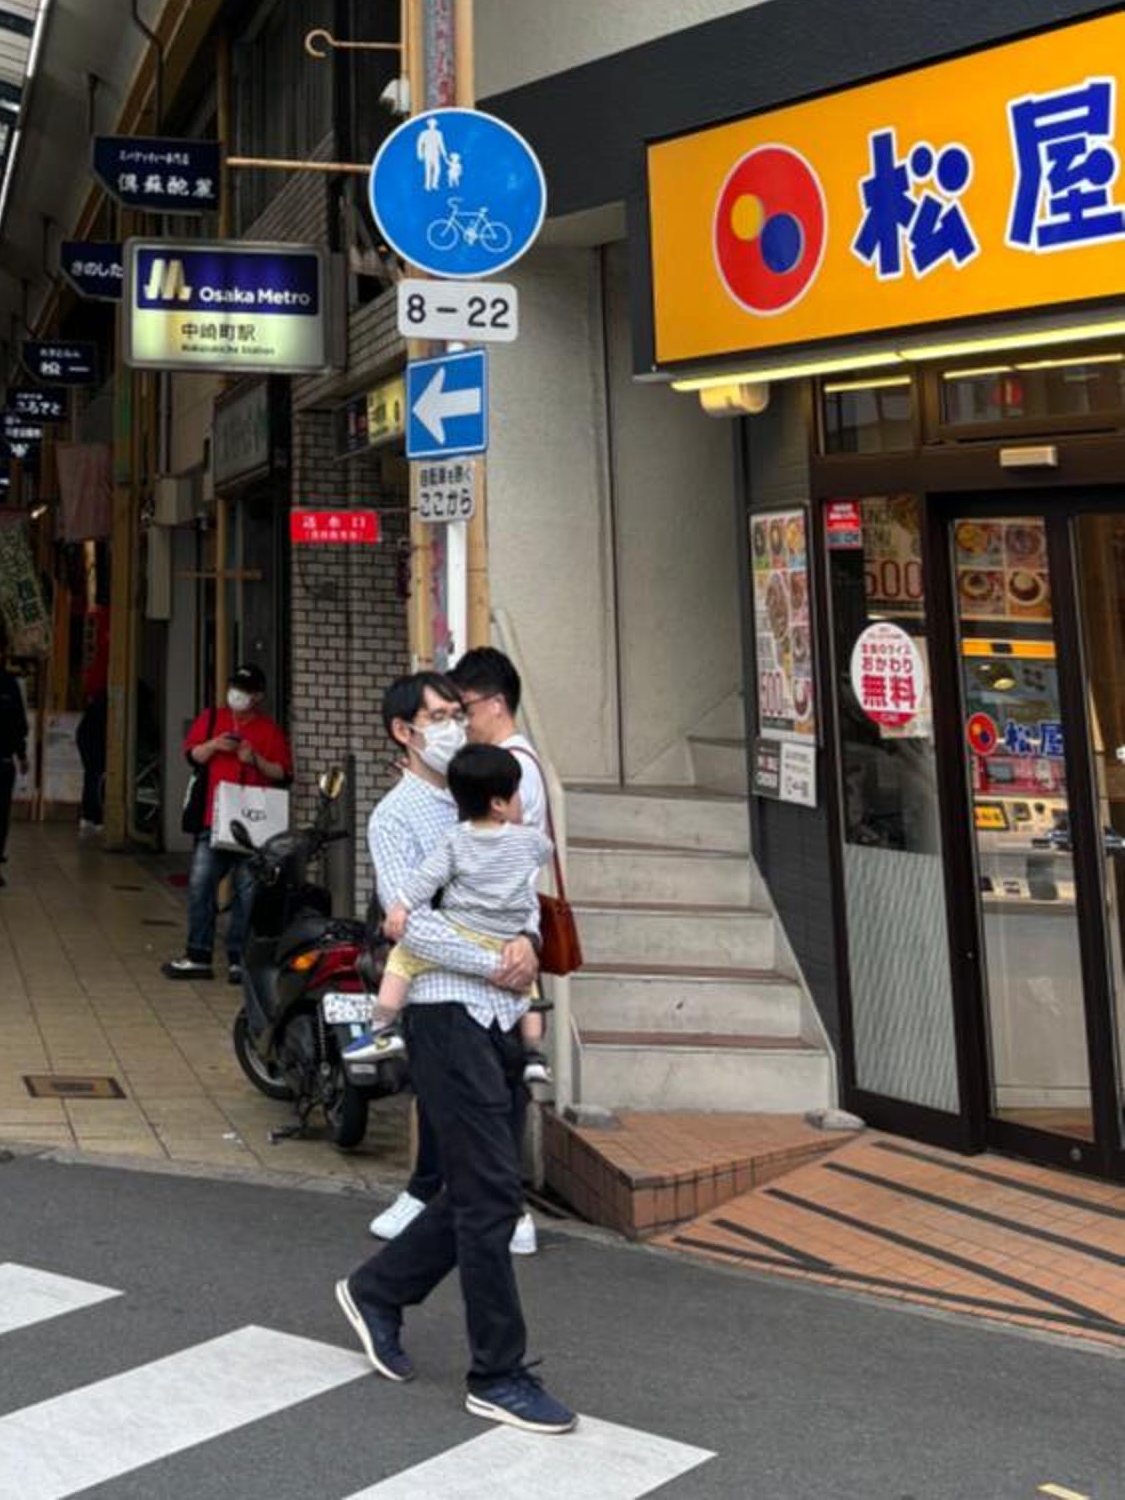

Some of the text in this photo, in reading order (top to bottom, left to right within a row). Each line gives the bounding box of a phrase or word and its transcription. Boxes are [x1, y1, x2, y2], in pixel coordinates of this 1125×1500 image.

[855, 82, 1125, 274] 松屋
[199, 286, 311, 306] Osaka Metro
[181, 323, 256, 342] 中崎町駅
[420, 488, 472, 517] ここから
[862, 657, 914, 673] おかわり
[862, 674, 917, 709] 無料
